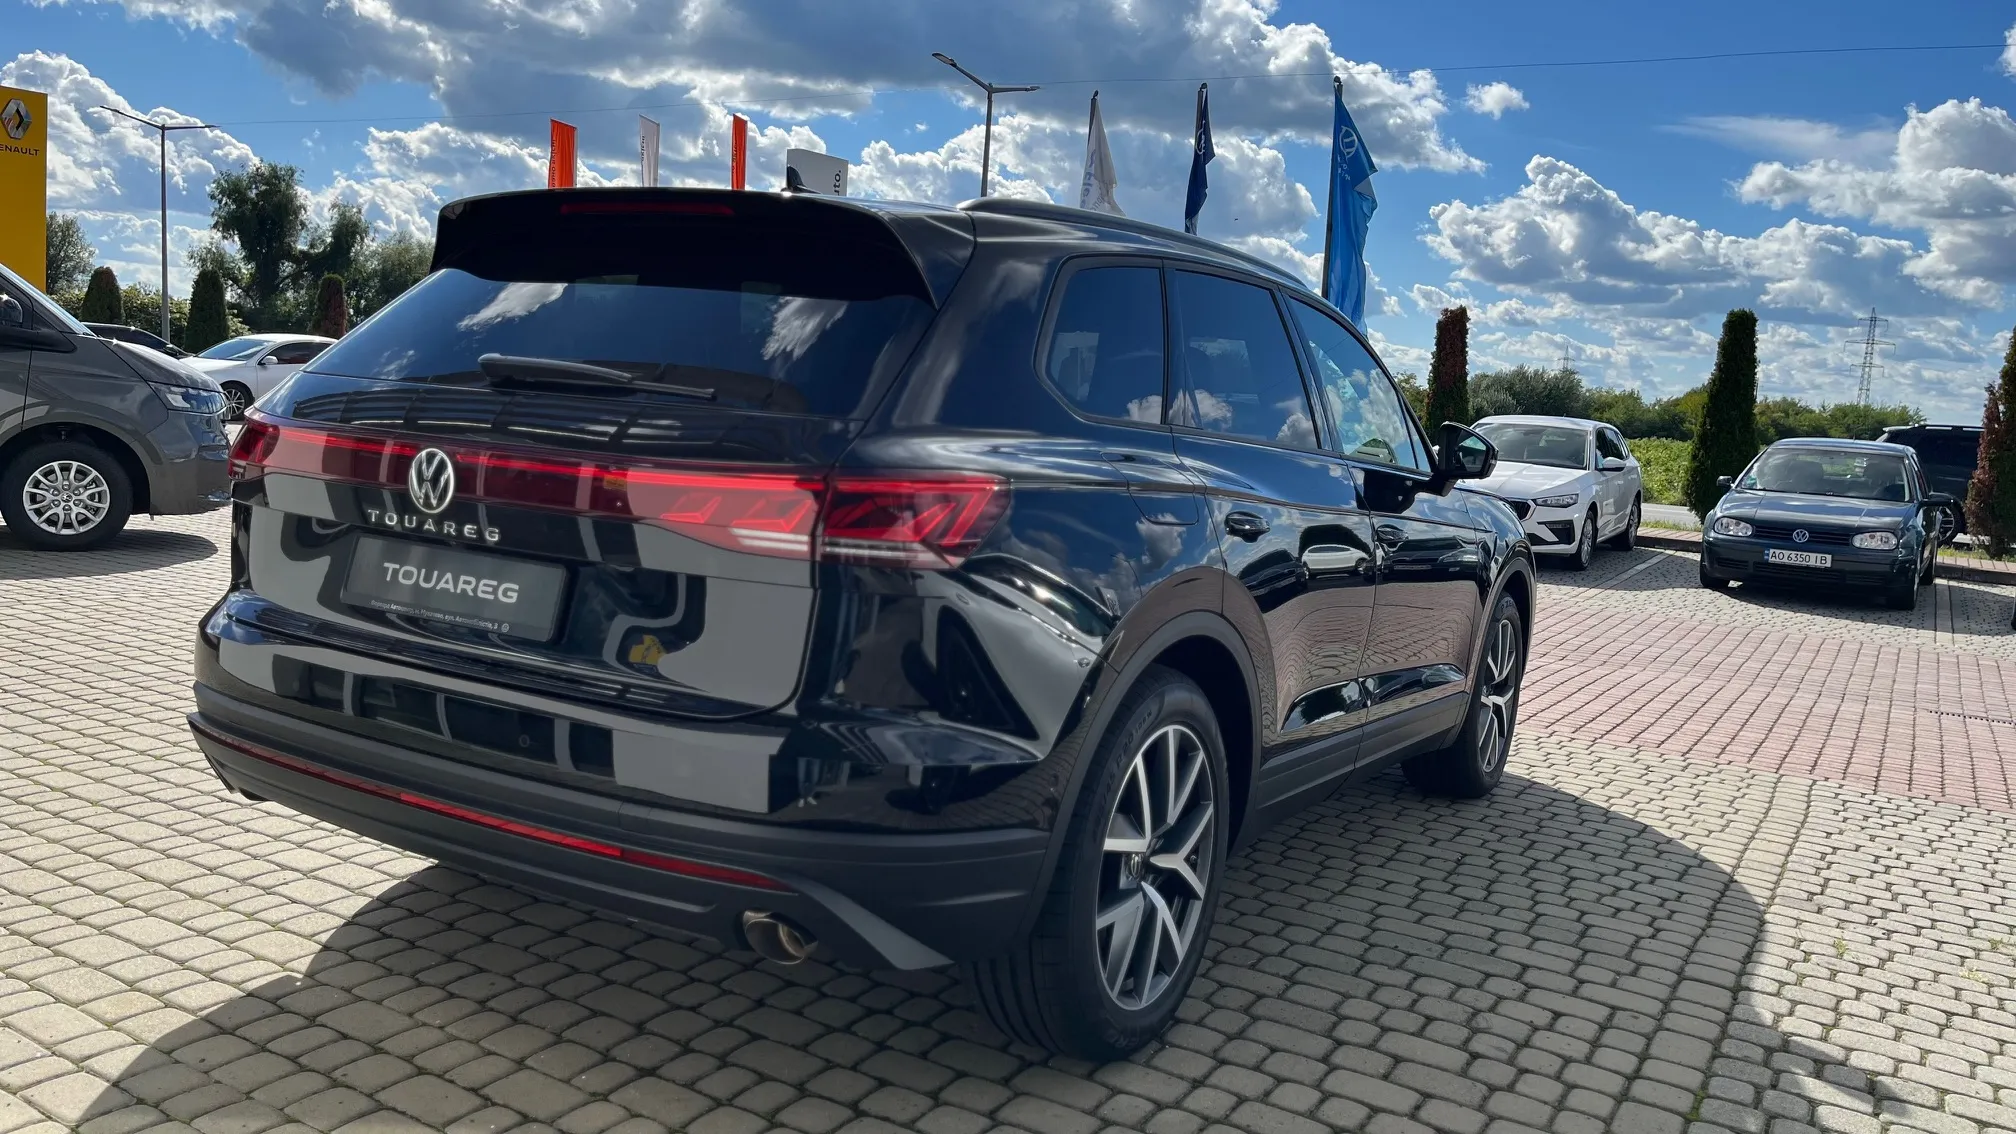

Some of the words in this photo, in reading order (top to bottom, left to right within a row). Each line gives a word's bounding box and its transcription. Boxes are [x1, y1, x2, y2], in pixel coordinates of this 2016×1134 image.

[367, 509, 500, 541] TOUAREG
[1770, 551, 1784, 560] AO
[1787, 553, 1811, 563] 6350
[1815, 555, 1828, 565] IB
[383, 562, 521, 604] TOUAREG
